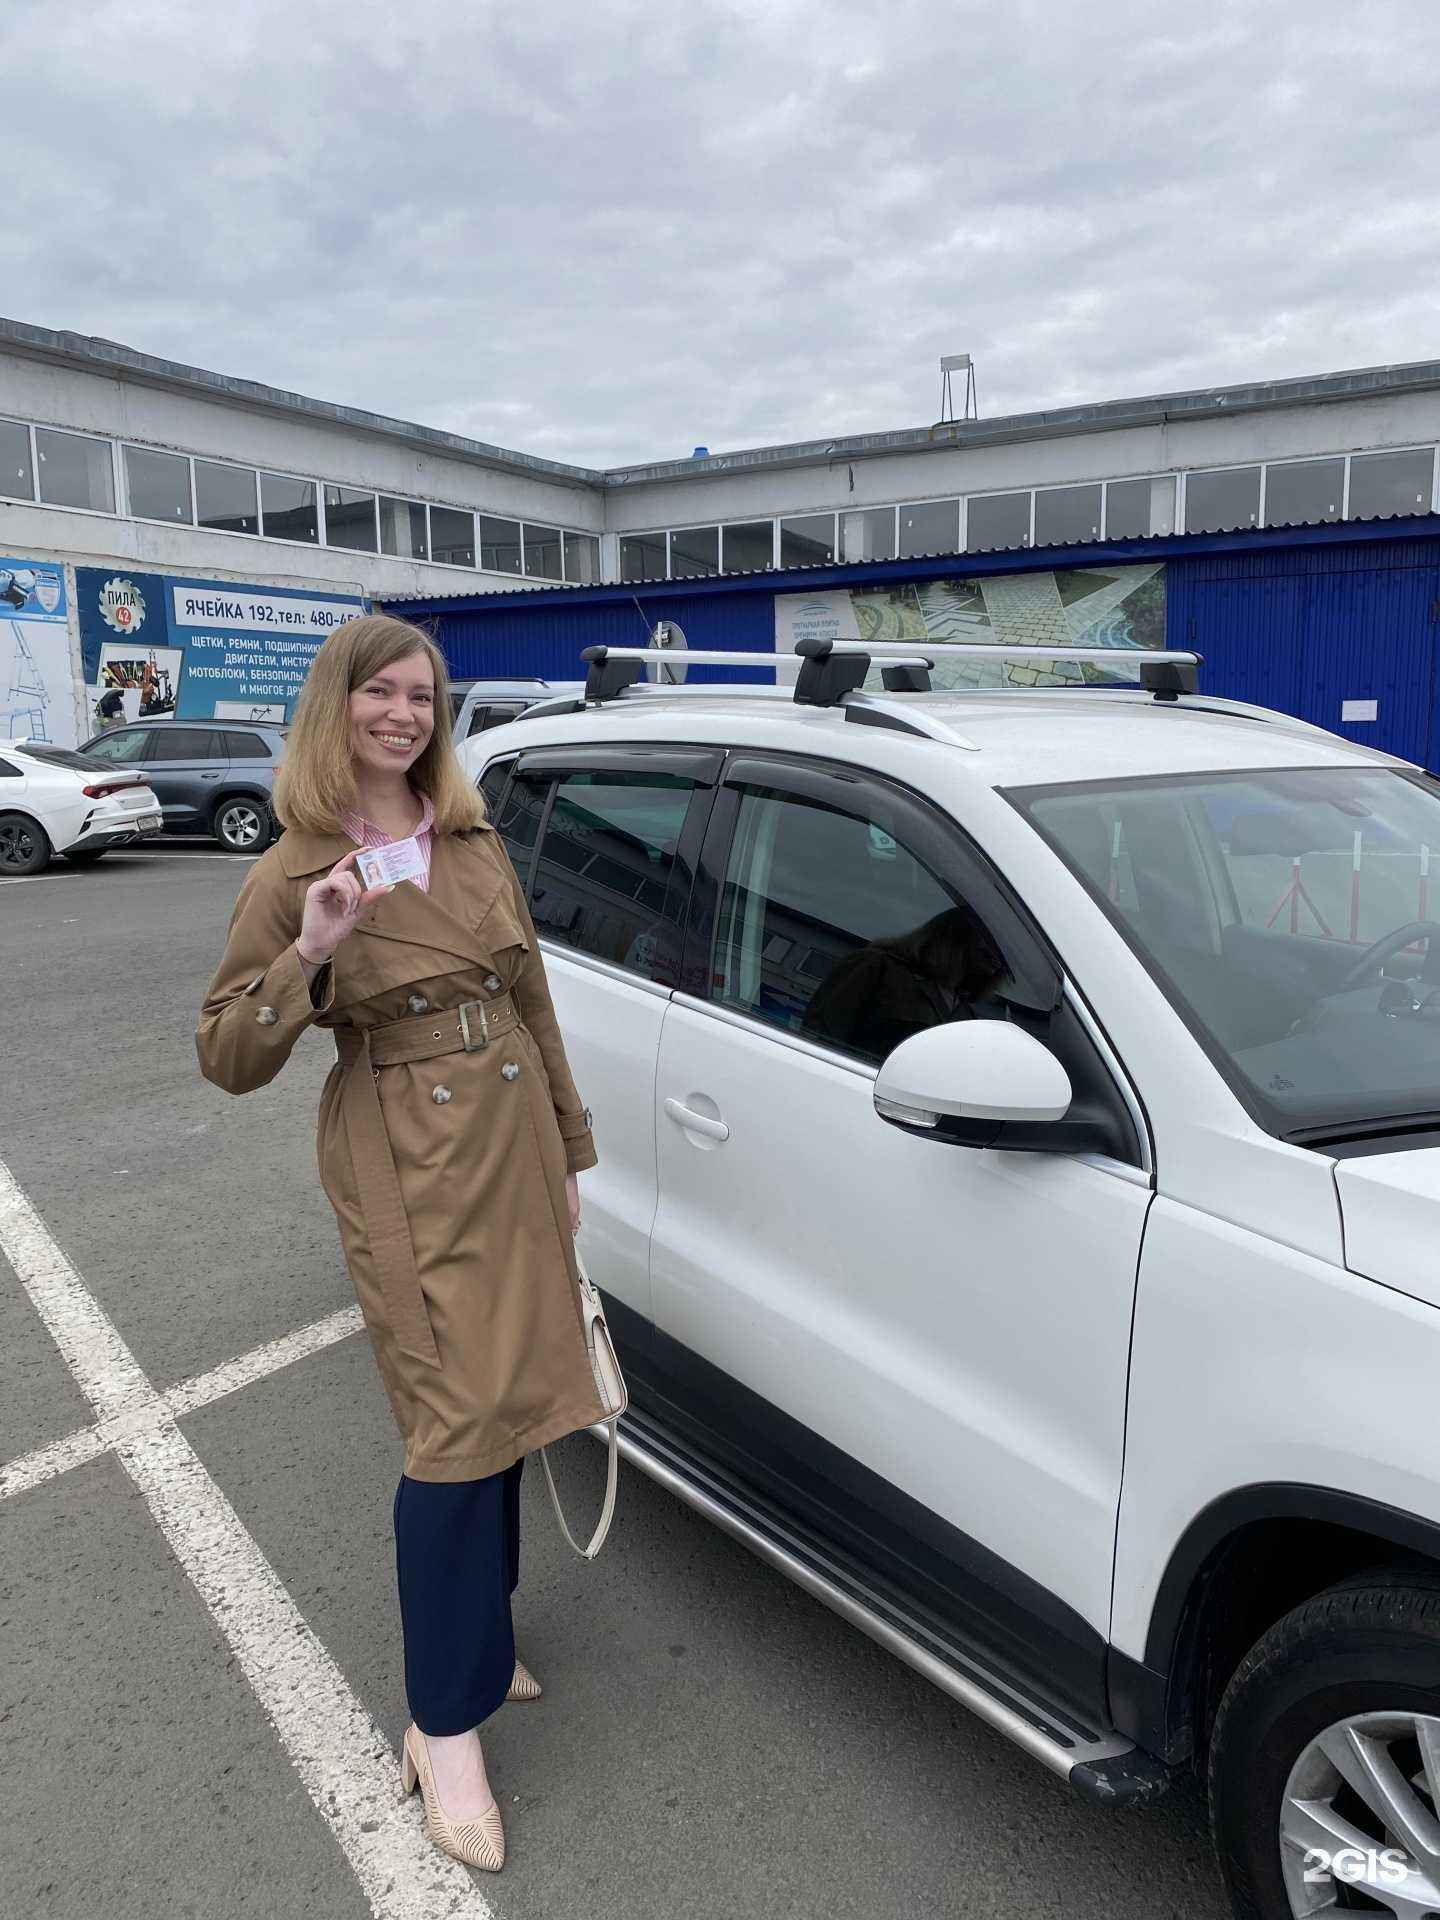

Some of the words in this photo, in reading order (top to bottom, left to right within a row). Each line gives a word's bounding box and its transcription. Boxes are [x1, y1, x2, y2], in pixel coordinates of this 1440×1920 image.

[107, 591, 136, 606] ПИЛА
[185, 597, 244, 620] ЯЧЕЙКА
[118, 609, 130, 623] 42
[191, 636, 227, 650] ЩЕТКИ,
[228, 638, 263, 652] РЕМНИ,
[264, 640, 321, 654] ПОДШИПНИК
[224, 653, 279, 667] ДВИГАТЕЛИ,
[188, 667, 248, 680] МОТОБЛОКИ,
[239, 684, 247, 695] И
[249, 684, 284, 696] МНОГОЕ
[286, 686, 304, 697] ДРУ
